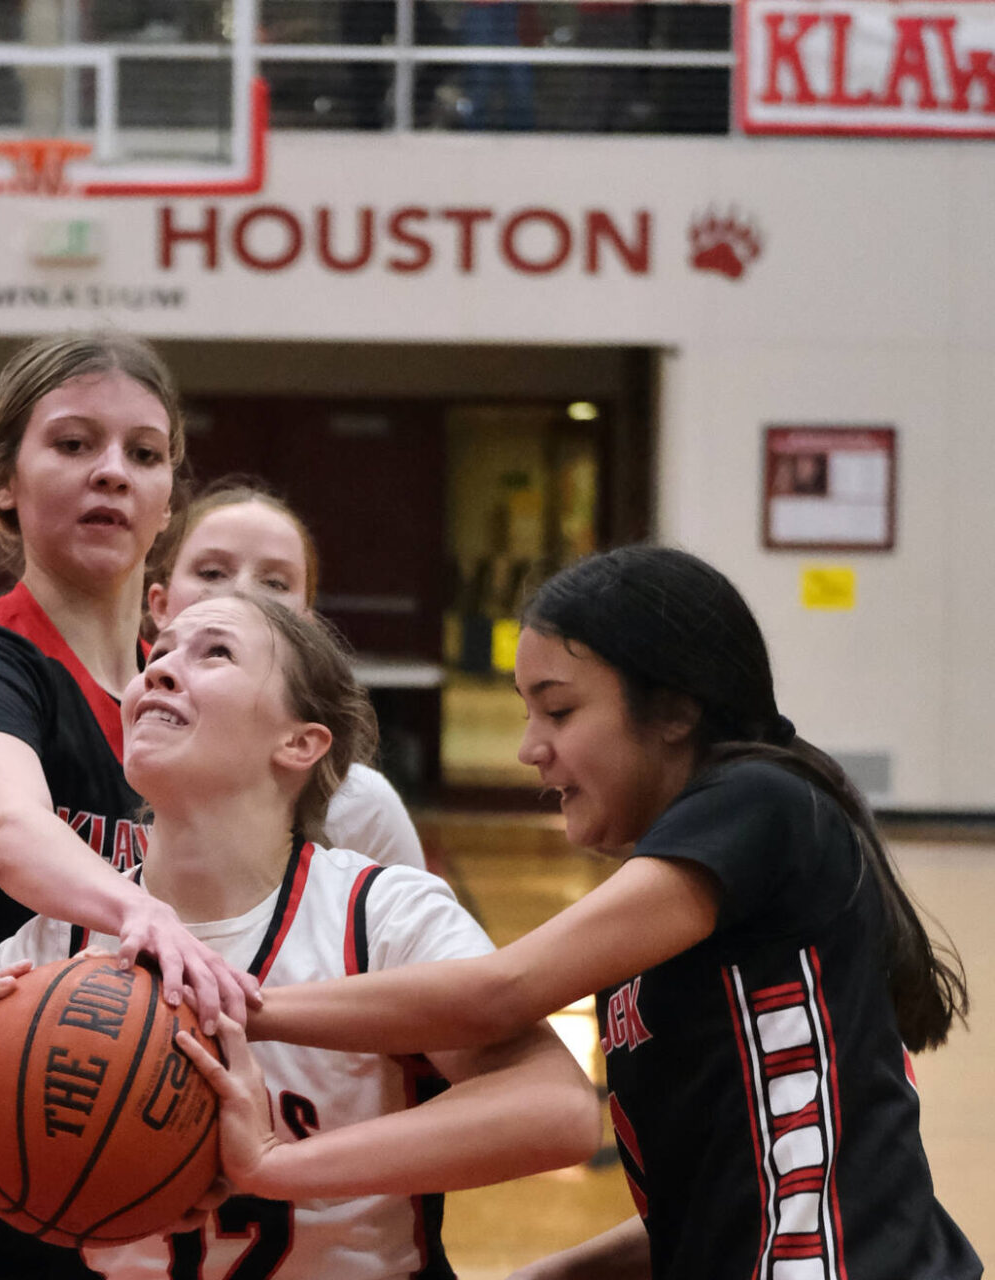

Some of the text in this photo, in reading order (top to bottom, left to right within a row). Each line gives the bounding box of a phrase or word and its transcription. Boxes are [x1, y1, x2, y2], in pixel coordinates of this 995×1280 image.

[159, 204, 653, 276] HOUSTON
[43, 964, 136, 1139] THE ROCK
